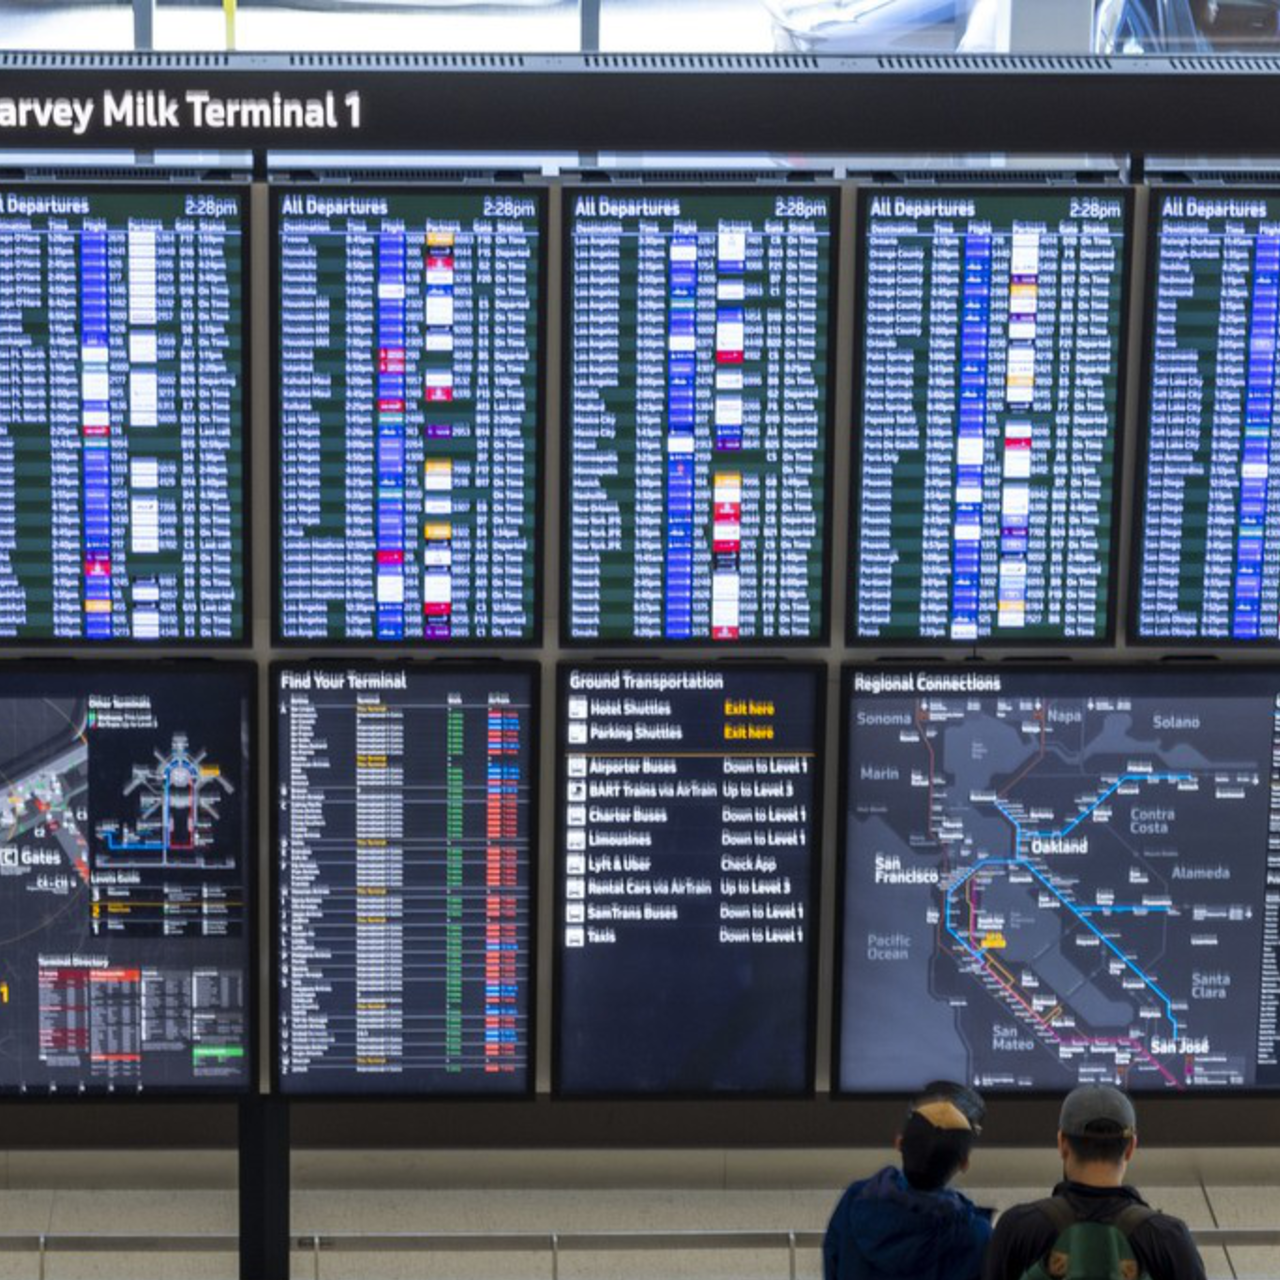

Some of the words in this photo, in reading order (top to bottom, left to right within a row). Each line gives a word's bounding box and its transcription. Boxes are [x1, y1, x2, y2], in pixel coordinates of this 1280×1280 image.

[103, 91, 179, 127] Milk
[185, 91, 338, 127] Terminal
[345, 91, 360, 127] 1
[7, 195, 89, 215] Departures
[185, 198, 238, 217] 2:28pm
[282, 197, 303, 215] All
[306, 197, 388, 217] Departures
[483, 199, 535, 218] 2:28pm
[575, 198, 596, 216] All
[599, 198, 680, 218] Departures
[775, 200, 826, 218] 2:28pm
[871, 198, 891, 217] All
[895, 198, 975, 219] Departures
[1070, 200, 1121, 219] 2:28pm
[1162, 199, 1183, 217] All
[1186, 199, 1267, 219] Departures
[281, 674, 311, 689] Find
[313, 674, 345, 689] Your
[347, 674, 407, 689] Terminal
[570, 672, 620, 689] Ground
[622, 672, 724, 691] Transportation
[855, 676, 914, 692] Regional
[916, 676, 1001, 691] Connections
[590, 701, 622, 715] Hotel
[623, 701, 671, 715] Shuttles
[724, 702, 747, 715] Exit
[748, 702, 774, 715] here
[857, 712, 911, 725] Sonoma
[1047, 711, 1081, 724] Napa
[1153, 715, 1200, 729] Solano
[590, 725, 633, 741] Parking
[634, 725, 683, 739] Shuttles
[724, 725, 747, 739] Exit
[748, 725, 774, 739] here
[589, 760, 641, 776] Airporter
[642, 760, 677, 774] Buses
[723, 760, 754, 774] Down
[756, 760, 768, 774] to
[770, 760, 800, 774] Level
[802, 760, 807, 774] 1
[861, 768, 899, 780] Marin
[589, 783, 621, 797] BART
[623, 783, 657, 797] Trains
[658, 783, 674, 797] via
[676, 783, 717, 797] AirTrain
[722, 783, 739, 799] Up
[740, 783, 752, 797] to
[754, 783, 784, 797] Level
[786, 783, 794, 797] 3
[589, 807, 632, 822] Charter
[633, 807, 668, 822] Buses
[1130, 808, 1175, 821] Contra
[1130, 822, 1168, 834] Costa
[588, 832, 652, 846] Limousines
[1031, 839, 1088, 854] Oakland
[2, 849, 16, 865] C
[21, 849, 61, 865] Gates
[875, 857, 901, 870] San
[588, 857, 612, 873] Lyft
[613, 857, 622, 871] &
[623, 857, 651, 871] Uber
[721, 857, 753, 871] Check
[754, 857, 777, 873] App
[875, 870, 938, 883] Francisco
[1172, 867, 1230, 880] Alameda
[588, 880, 625, 894] Rental
[626, 880, 652, 894] Cars
[653, 880, 669, 894] via
[671, 880, 712, 894] AirTrain
[720, 880, 737, 896] Up
[738, 880, 750, 894] to
[751, 880, 782, 894] Level
[783, 880, 791, 894] 3
[587, 906, 642, 919] SamTrans
[644, 906, 678, 919] Buses
[720, 905, 751, 919] Down
[752, 905, 764, 919] to
[765, 905, 796, 919] Level
[798, 905, 804, 919] 1
[587, 929, 616, 943] Taxis
[719, 929, 750, 942] Down
[751, 929, 764, 942] to
[765, 929, 796, 942] Level
[797, 929, 803, 942] 1
[867, 934, 911, 947] Pacific
[867, 948, 908, 960] Ocean
[1192, 973, 1230, 986] Santa
[0, 985, 9, 1003] 1
[1191, 986, 1226, 999] Clara
[993, 1026, 1017, 1038] San
[993, 1038, 1034, 1051] Mateo
[1151, 1038, 1177, 1054] San
[1178, 1038, 1210, 1054] José
